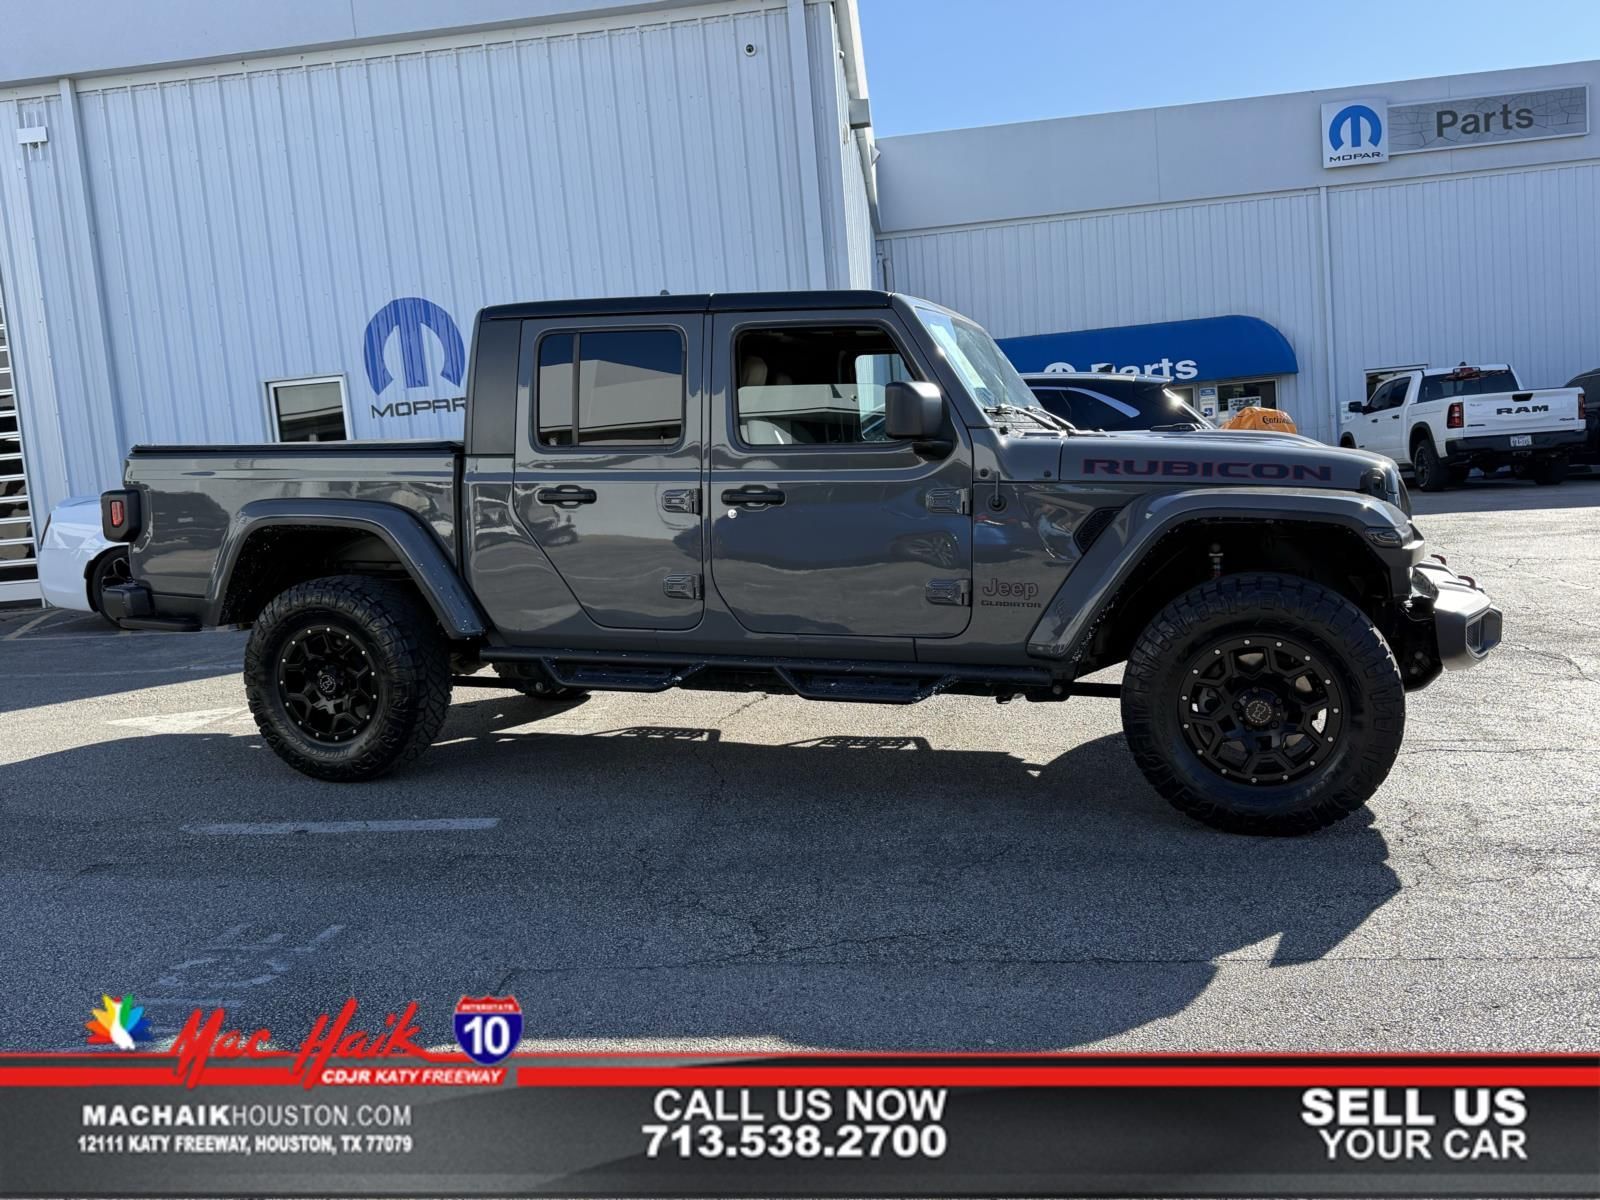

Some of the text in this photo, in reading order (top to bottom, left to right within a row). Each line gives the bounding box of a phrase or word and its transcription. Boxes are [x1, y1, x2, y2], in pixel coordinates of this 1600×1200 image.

[1436, 104, 1534, 138] Parts
[1329, 152, 1381, 162] MOPAR
[371, 397, 467, 419] MOPAR
[1496, 405, 1549, 416] RAM
[1082, 458, 1332, 481] RUBICON
[982, 578, 1039, 600] Jeep
[980, 600, 1042, 608] GLADIATOR
